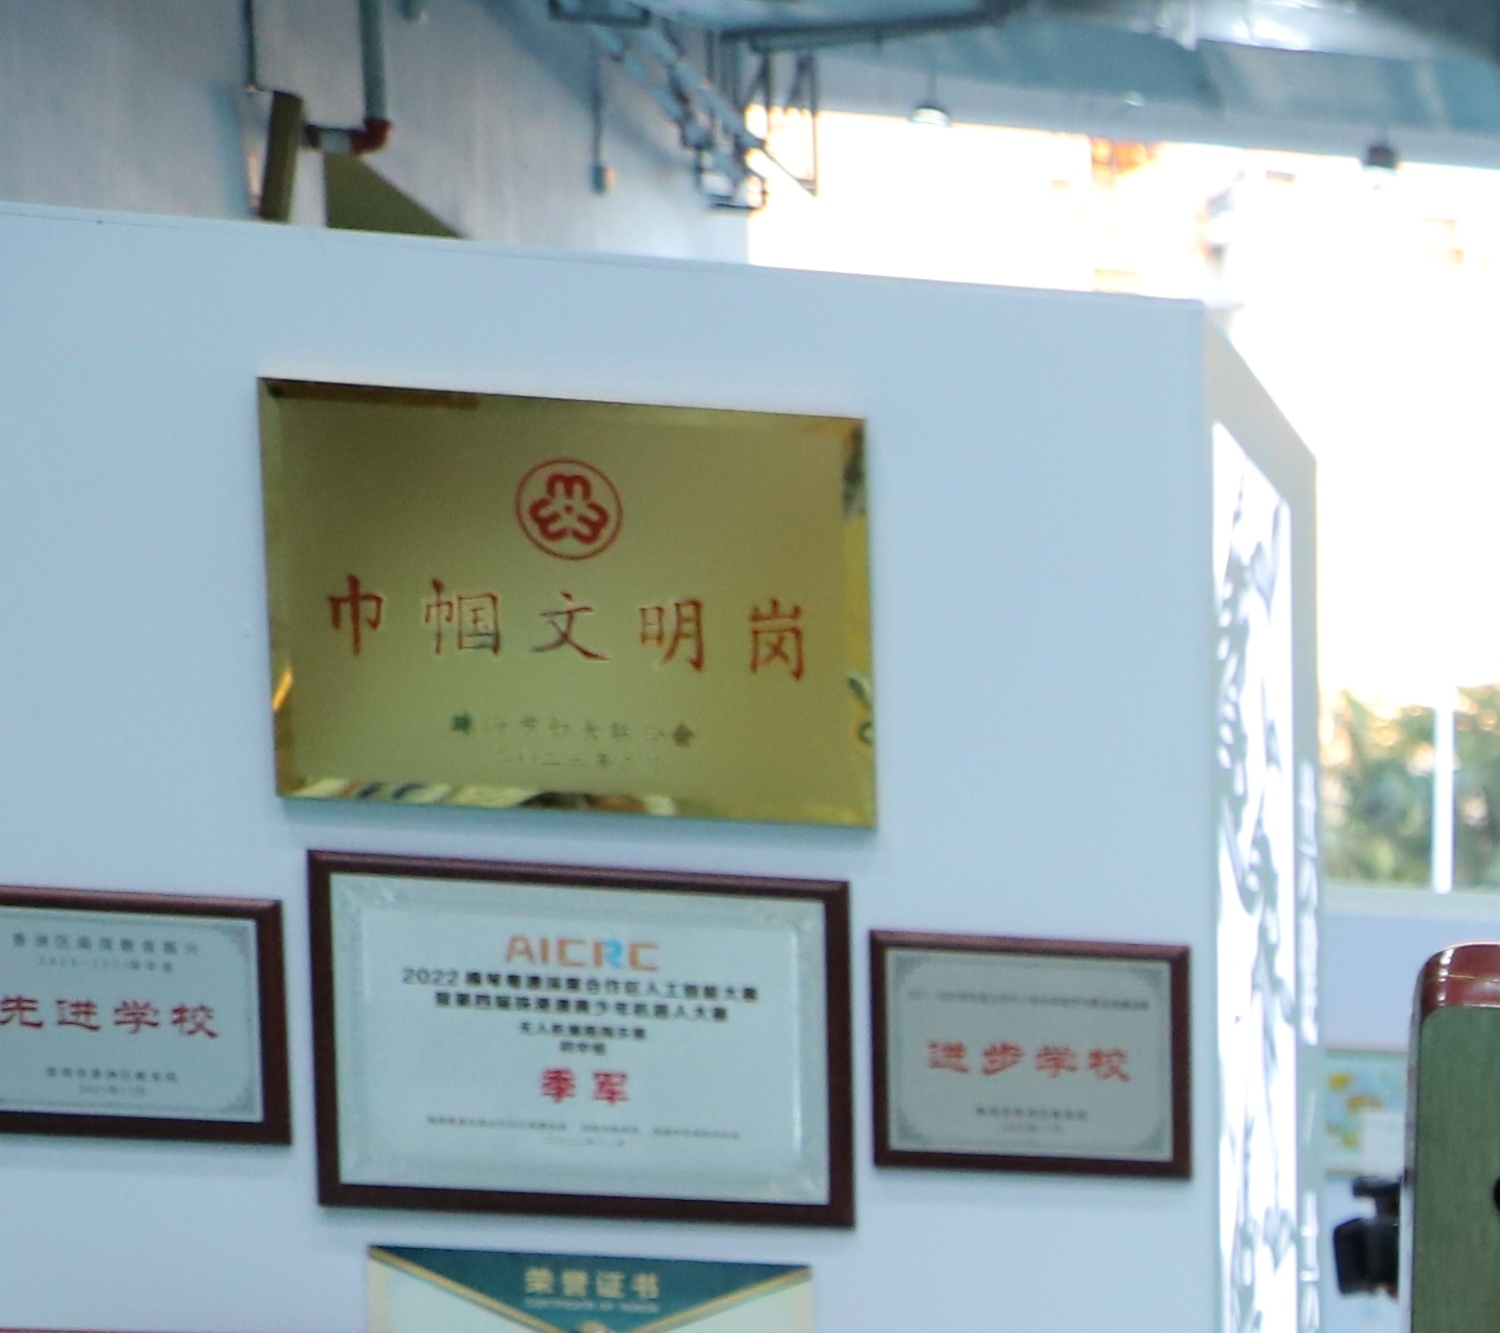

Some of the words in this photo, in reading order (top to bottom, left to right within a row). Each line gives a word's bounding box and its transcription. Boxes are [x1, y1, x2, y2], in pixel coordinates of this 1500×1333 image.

[328, 573, 806, 681] 巾帼文明岗
[505, 934, 659, 971] AICRC
[0, 994, 218, 1039] 先进学校
[927, 1038, 1131, 1083] 进步学校
[541, 1066, 630, 1105] 季军
[524, 1266, 660, 1301] 荣誉证书
